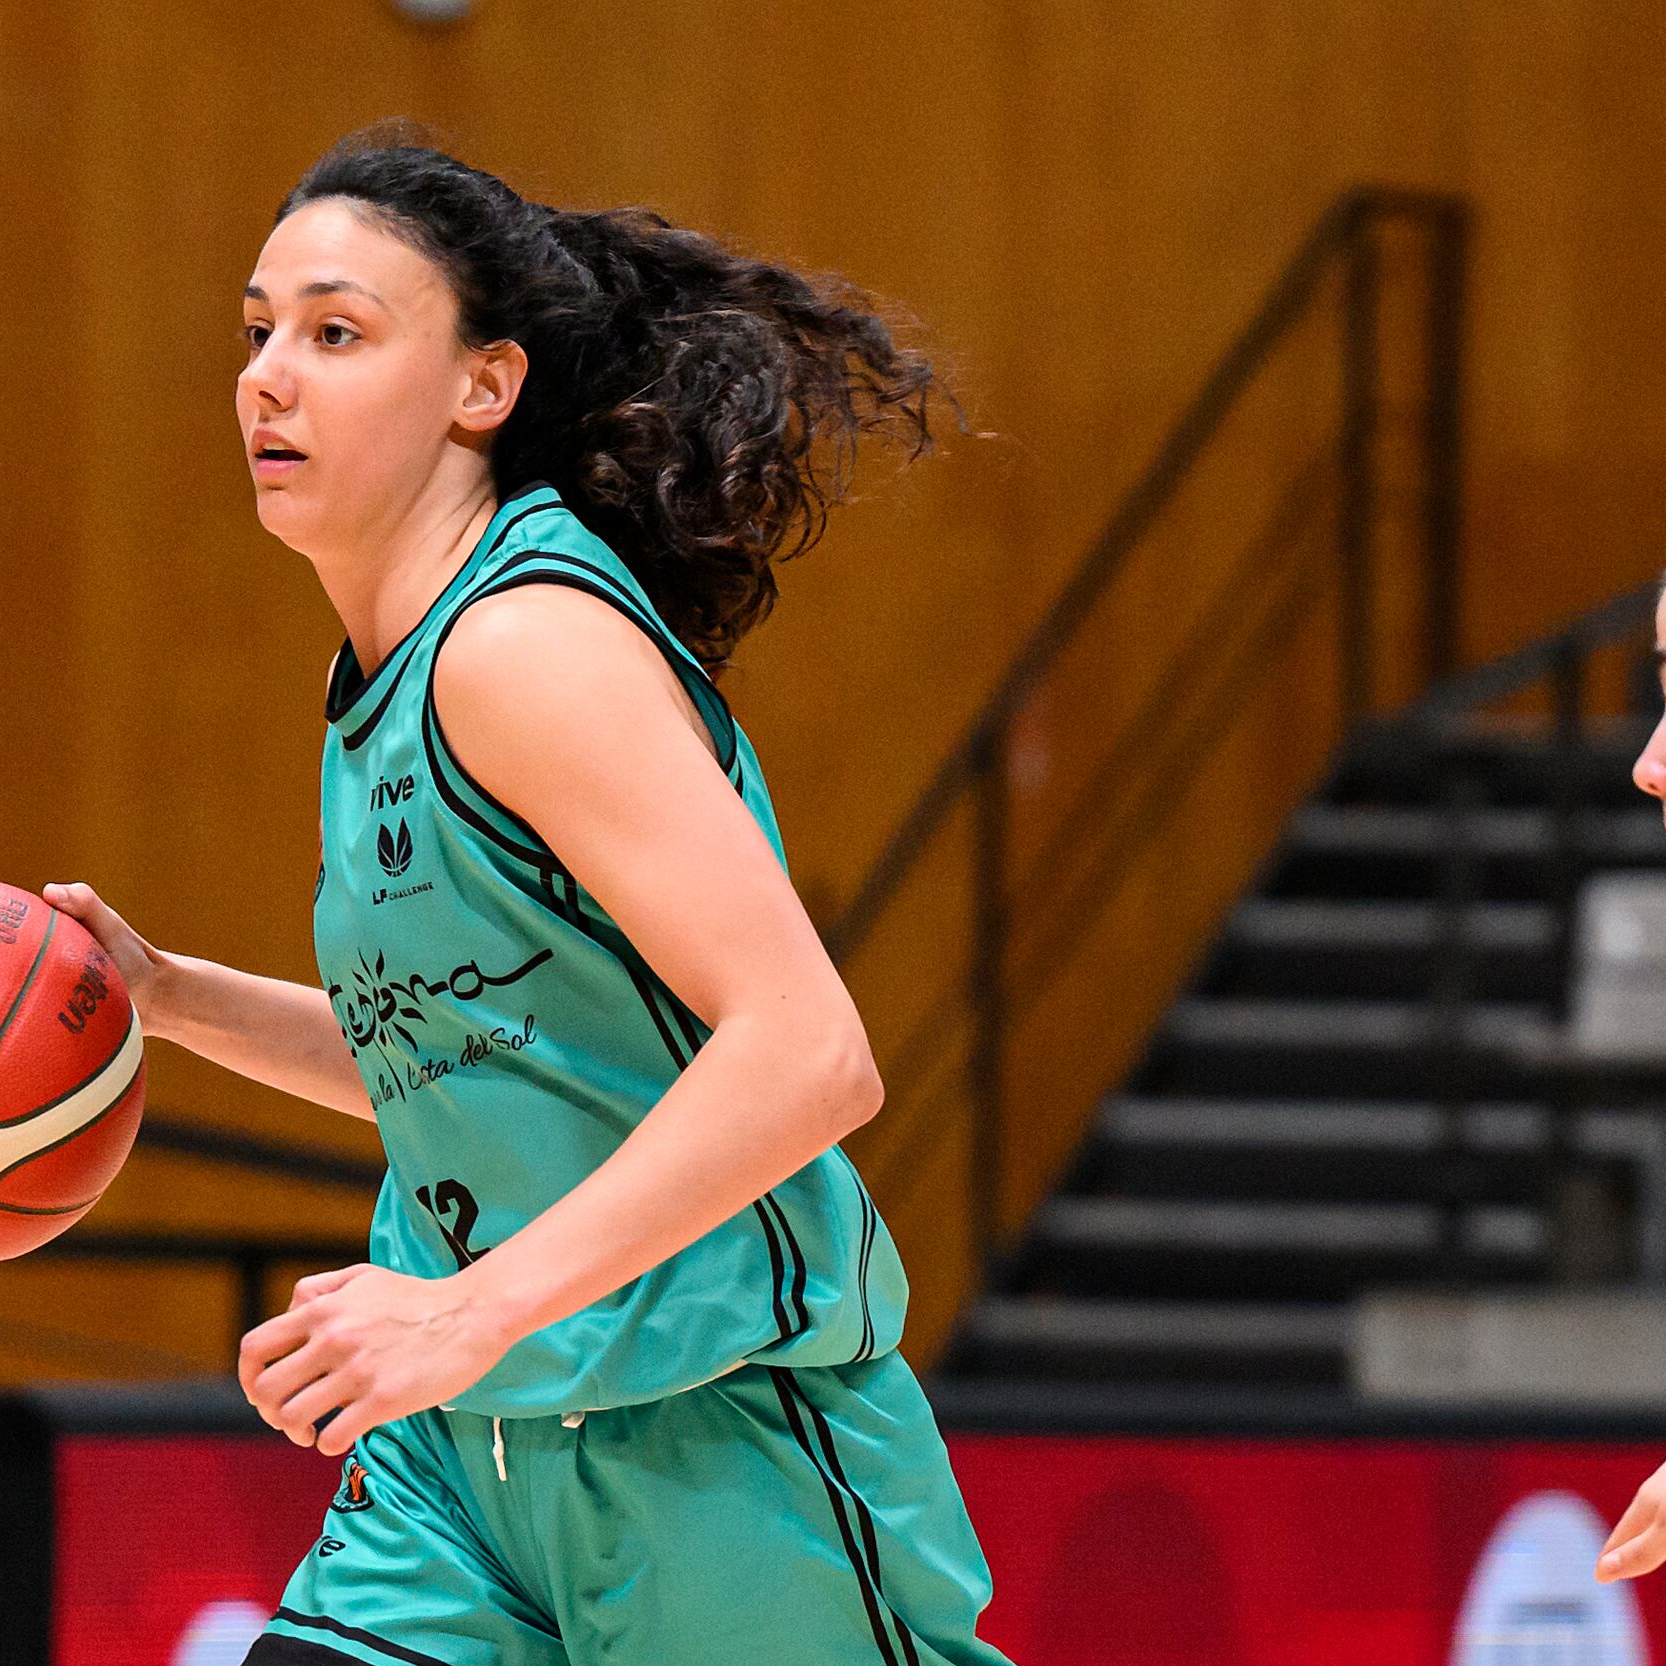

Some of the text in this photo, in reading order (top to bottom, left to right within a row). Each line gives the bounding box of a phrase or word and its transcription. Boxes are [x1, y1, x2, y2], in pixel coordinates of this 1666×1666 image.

[372, 881, 434, 905] LF CHALLENGE
[489, 1014, 536, 1051] Sol
